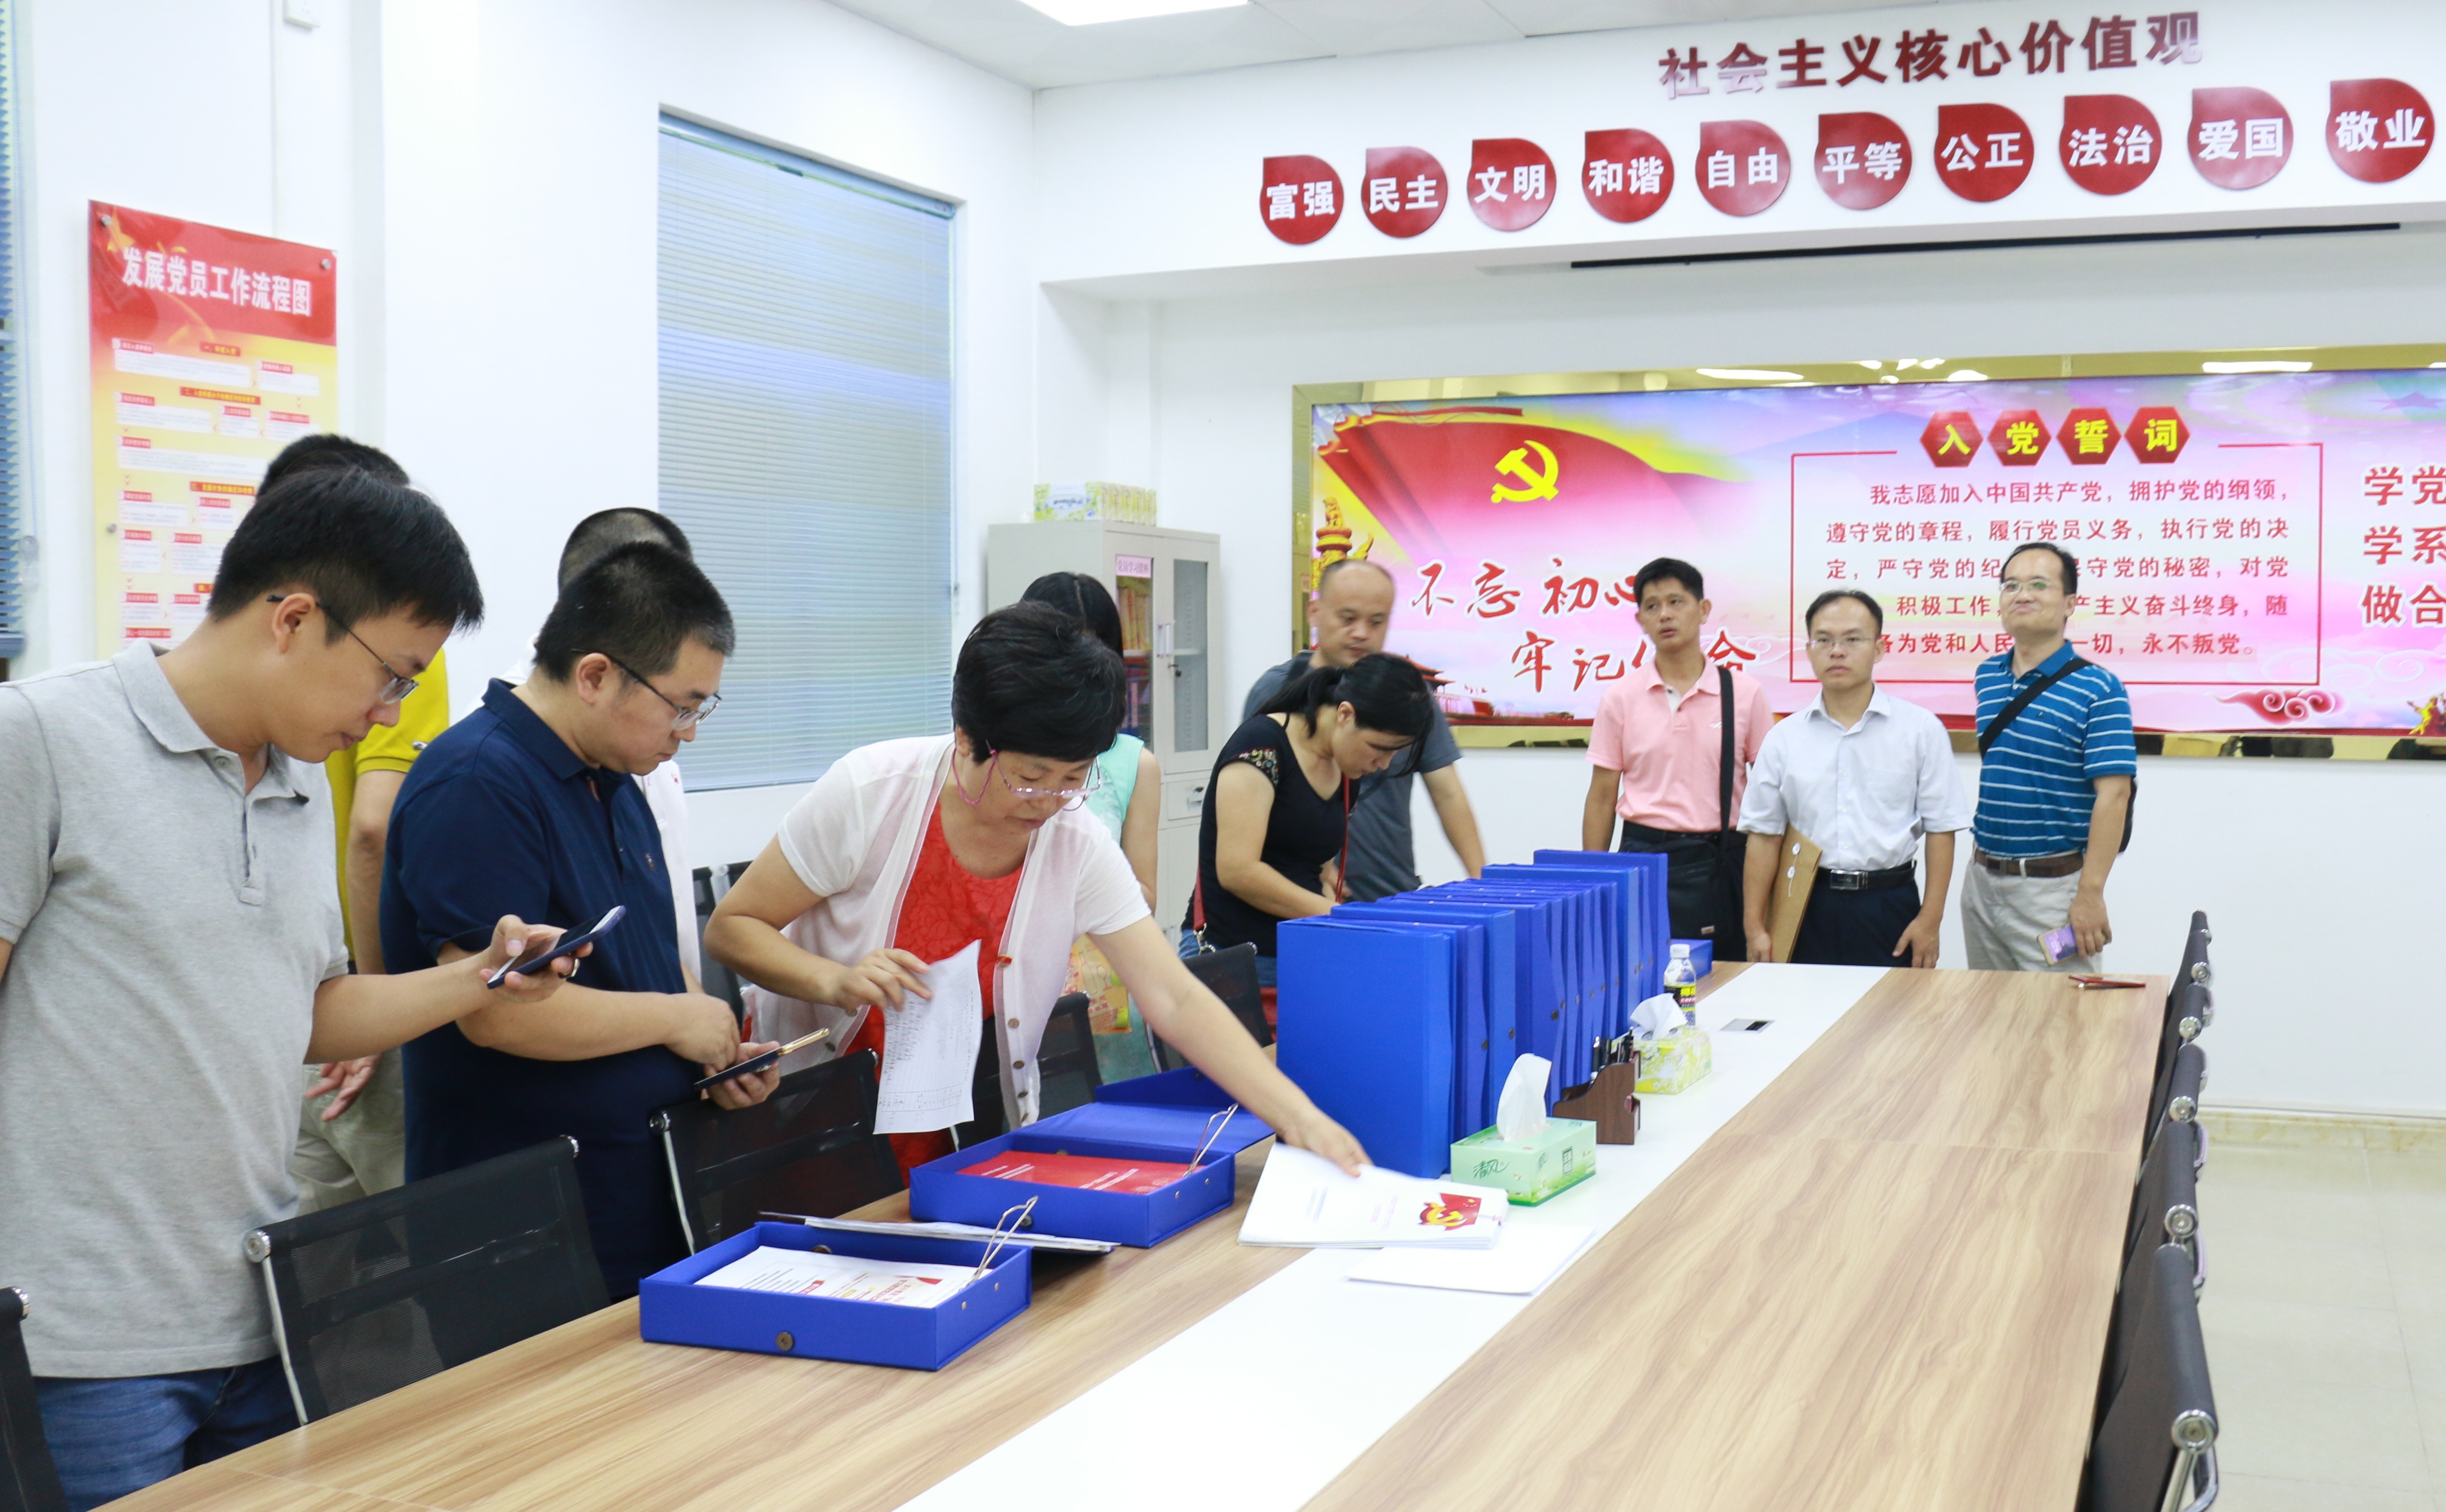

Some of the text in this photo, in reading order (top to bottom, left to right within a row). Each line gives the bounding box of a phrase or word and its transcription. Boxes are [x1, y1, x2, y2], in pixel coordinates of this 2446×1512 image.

[1658, 10, 2203, 99] 社会主义核心价值观
[1266, 108, 2426, 220] 富强 民主 文明 和谐 自由 平等 公正 法治 爱国 敬业
[122, 246, 312, 317] 发展党员工作流程图
[1938, 418, 2178, 455] 入党誓词
[2364, 466, 2446, 506] 学党
[1826, 517, 2289, 543] 遵守党的章程，履行党员义务，执行党的决
[2363, 525, 2446, 565] 学系
[2361, 583, 2446, 624] 做合
